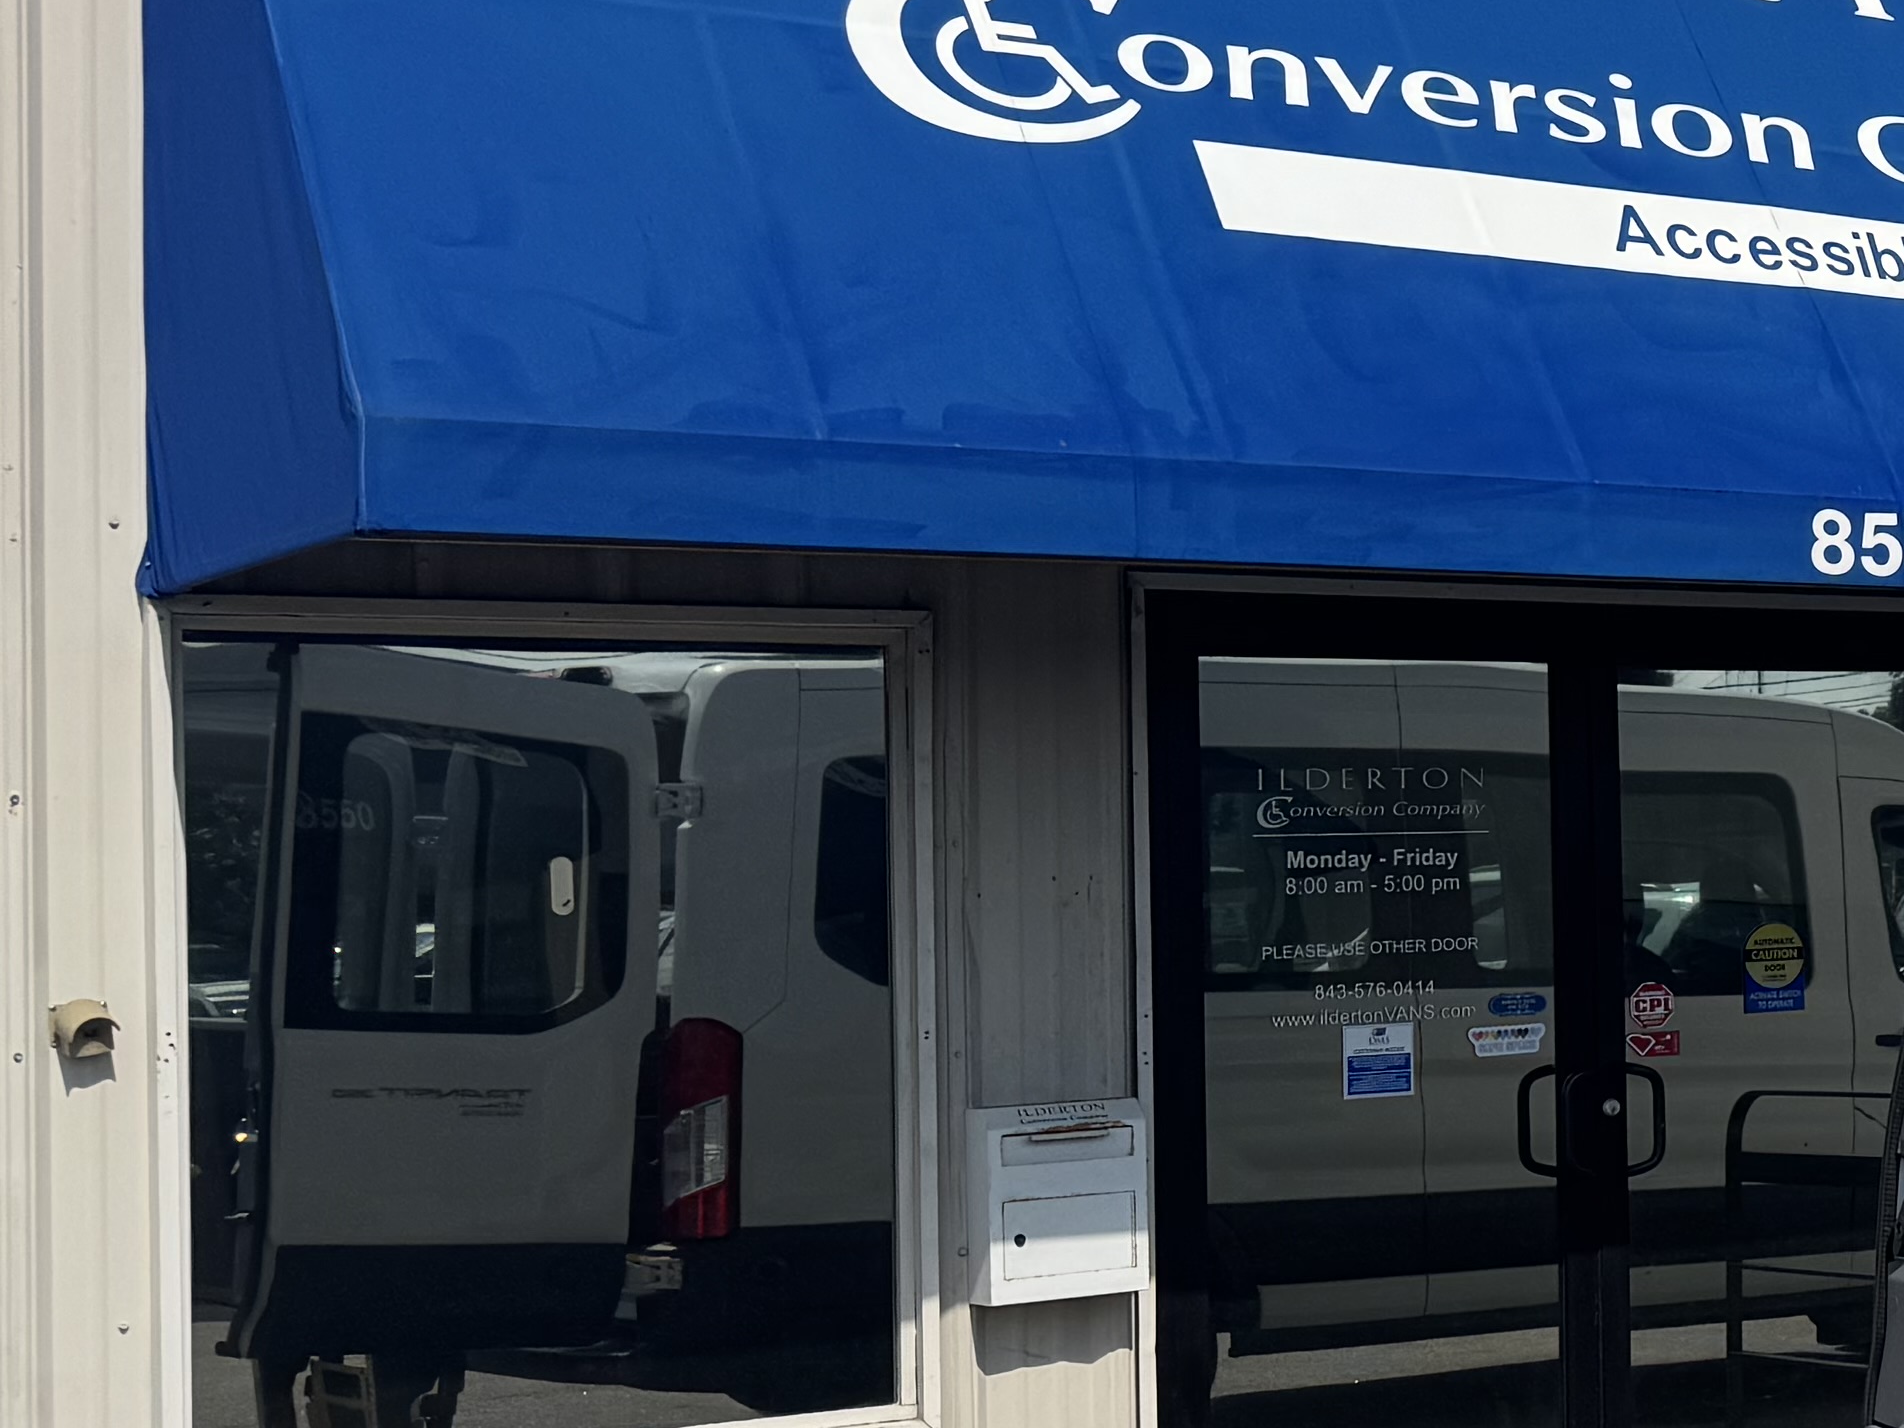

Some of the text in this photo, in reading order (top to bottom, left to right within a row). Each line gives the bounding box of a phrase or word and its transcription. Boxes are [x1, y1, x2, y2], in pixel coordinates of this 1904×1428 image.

[1257, 767, 1484, 791] ILDERTON
[1256, 796, 1486, 829] Conversion Company
[1287, 850, 1372, 872] Monday
[1393, 849, 1458, 871] Friday
[1285, 876, 1328, 895] 8:00
[1334, 880, 1364, 894] am
[1384, 874, 1425, 893] 5:00
[1432, 876, 1460, 895] pm
[1262, 937, 1479, 961] PLEASE USE OTHER DOOR
[1751, 948, 1798, 960] CAUTION
[1314, 980, 1436, 1001] 843-576-0414
[1272, 1004, 1477, 1028] www.ildertonVANS.com
[1635, 997, 1670, 1013] CPI
